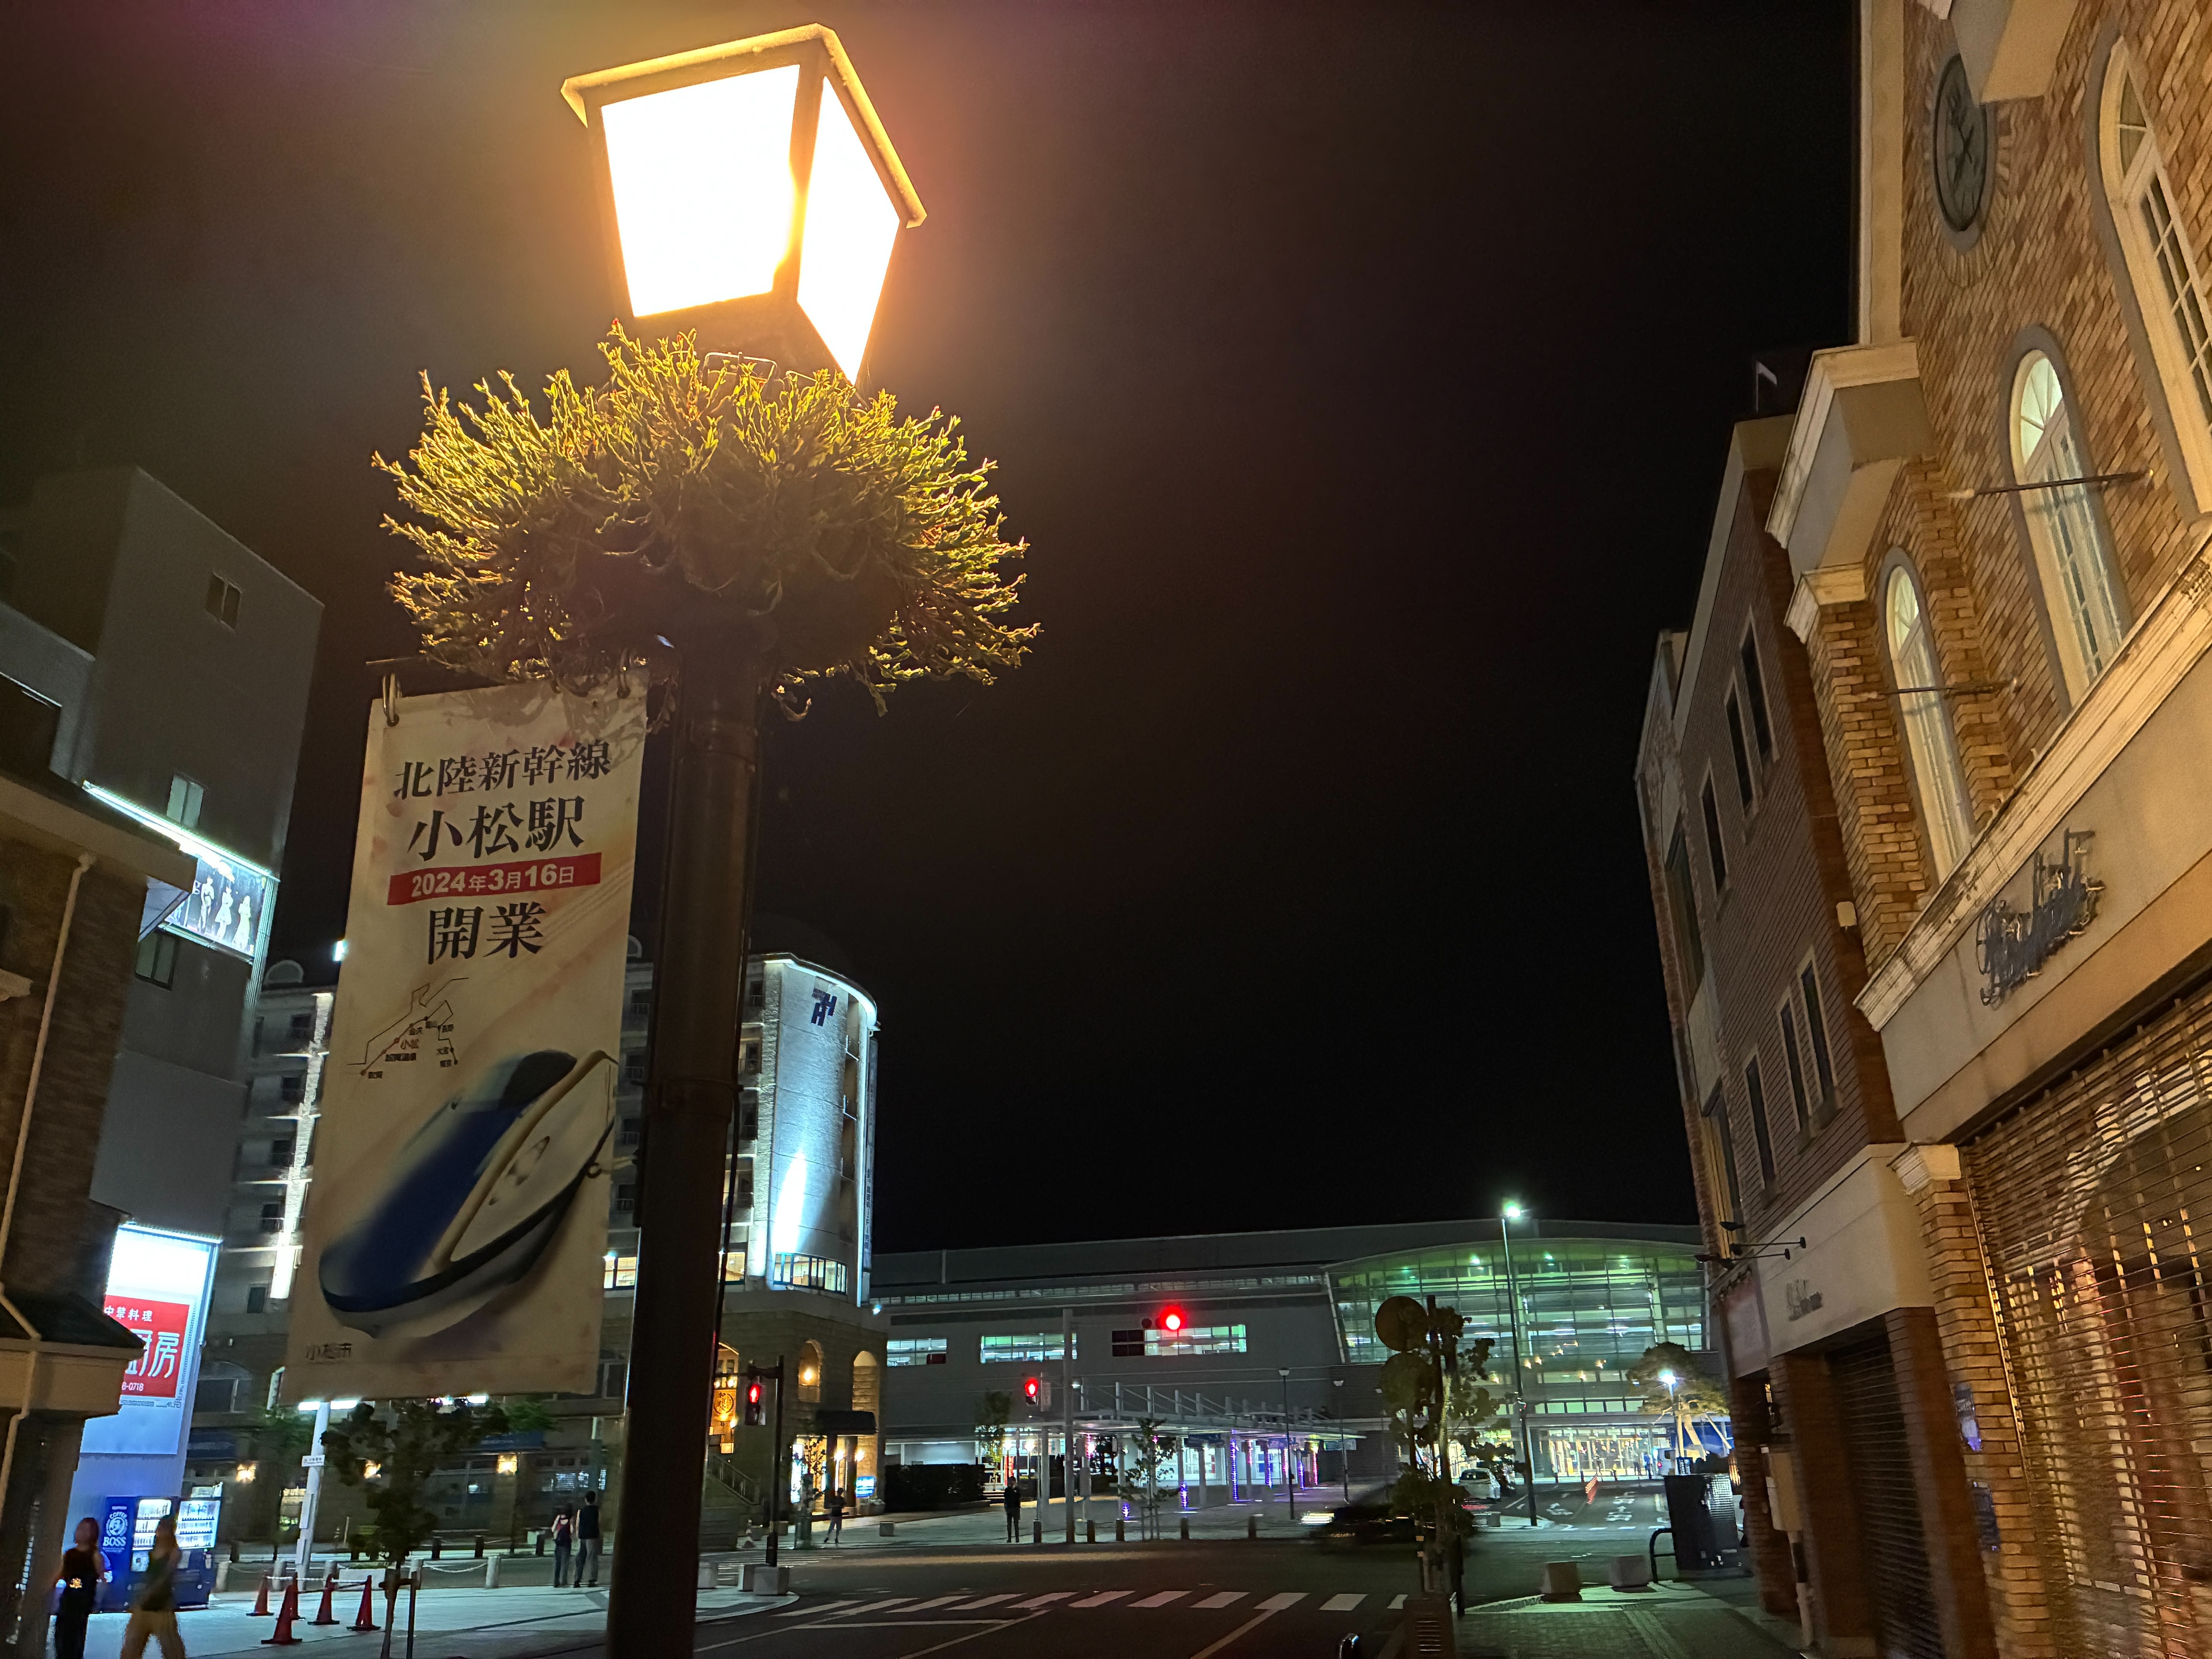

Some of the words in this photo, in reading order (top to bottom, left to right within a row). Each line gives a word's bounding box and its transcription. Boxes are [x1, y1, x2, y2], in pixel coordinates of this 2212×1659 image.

[393, 739, 611, 800] 北陸新幹線
[408, 795, 585, 862] 小松駅
[411, 864, 575, 898] 2024年3月16日
[428, 901, 546, 965] 開業
[104, 1305, 153, 1322] 中華料理
[103, 1537, 126, 1546] BOSS
